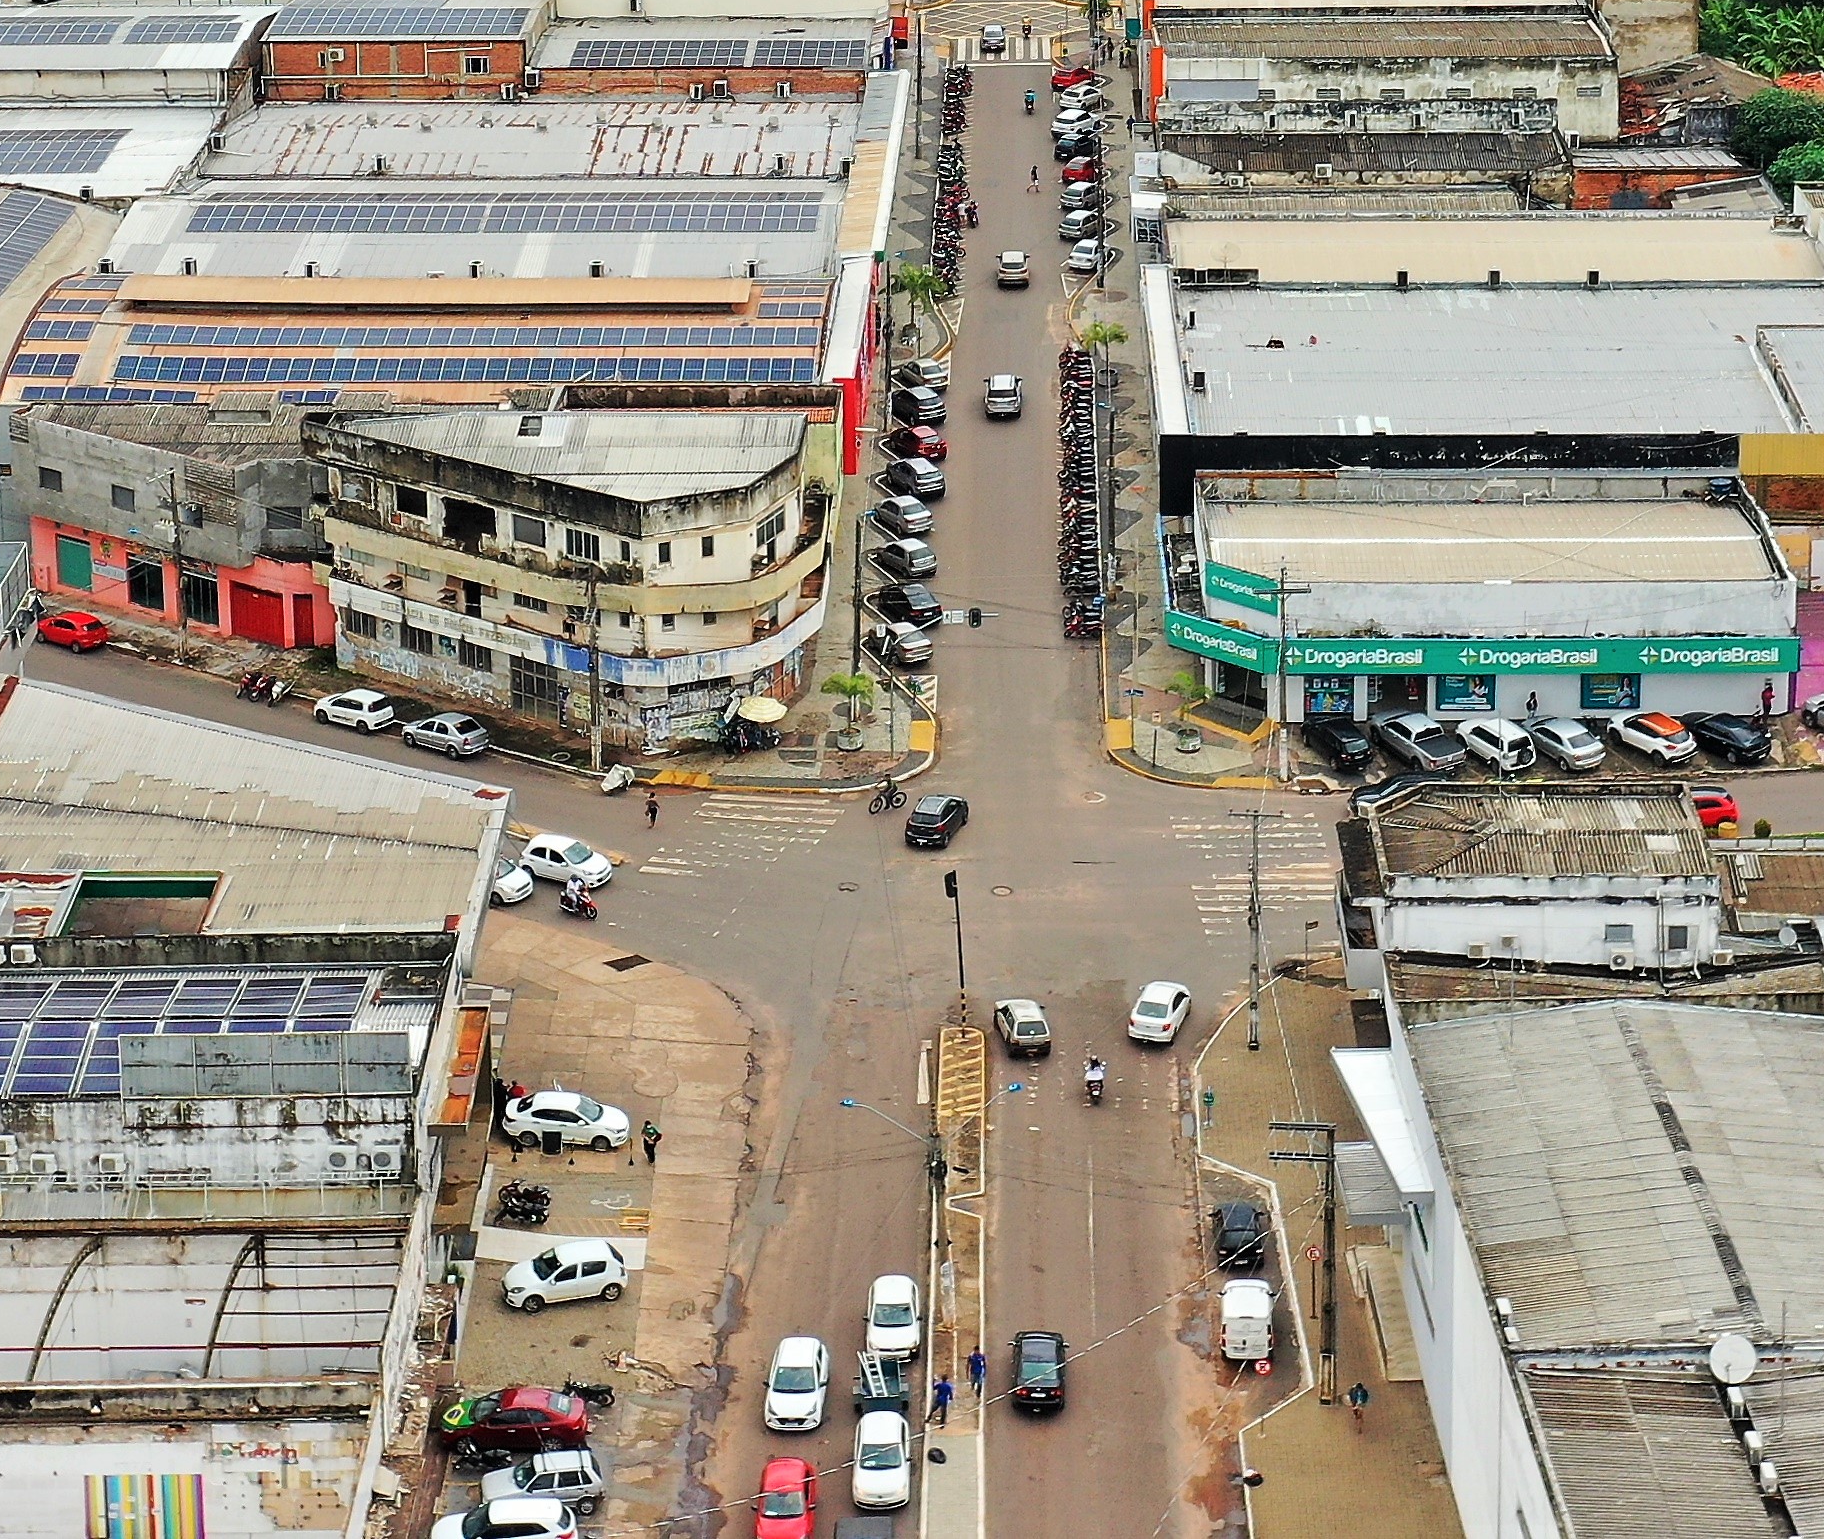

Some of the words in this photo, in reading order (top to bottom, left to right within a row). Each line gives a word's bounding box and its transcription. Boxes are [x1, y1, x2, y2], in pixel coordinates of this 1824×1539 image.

[1182, 626, 1258, 662] DrogariaBrasil
[1304, 648, 1423, 668] DrogariaBrasil
[1479, 648, 1597, 668] DrogariaBrasil
[1660, 647, 1779, 667] DrogariaBrasil
